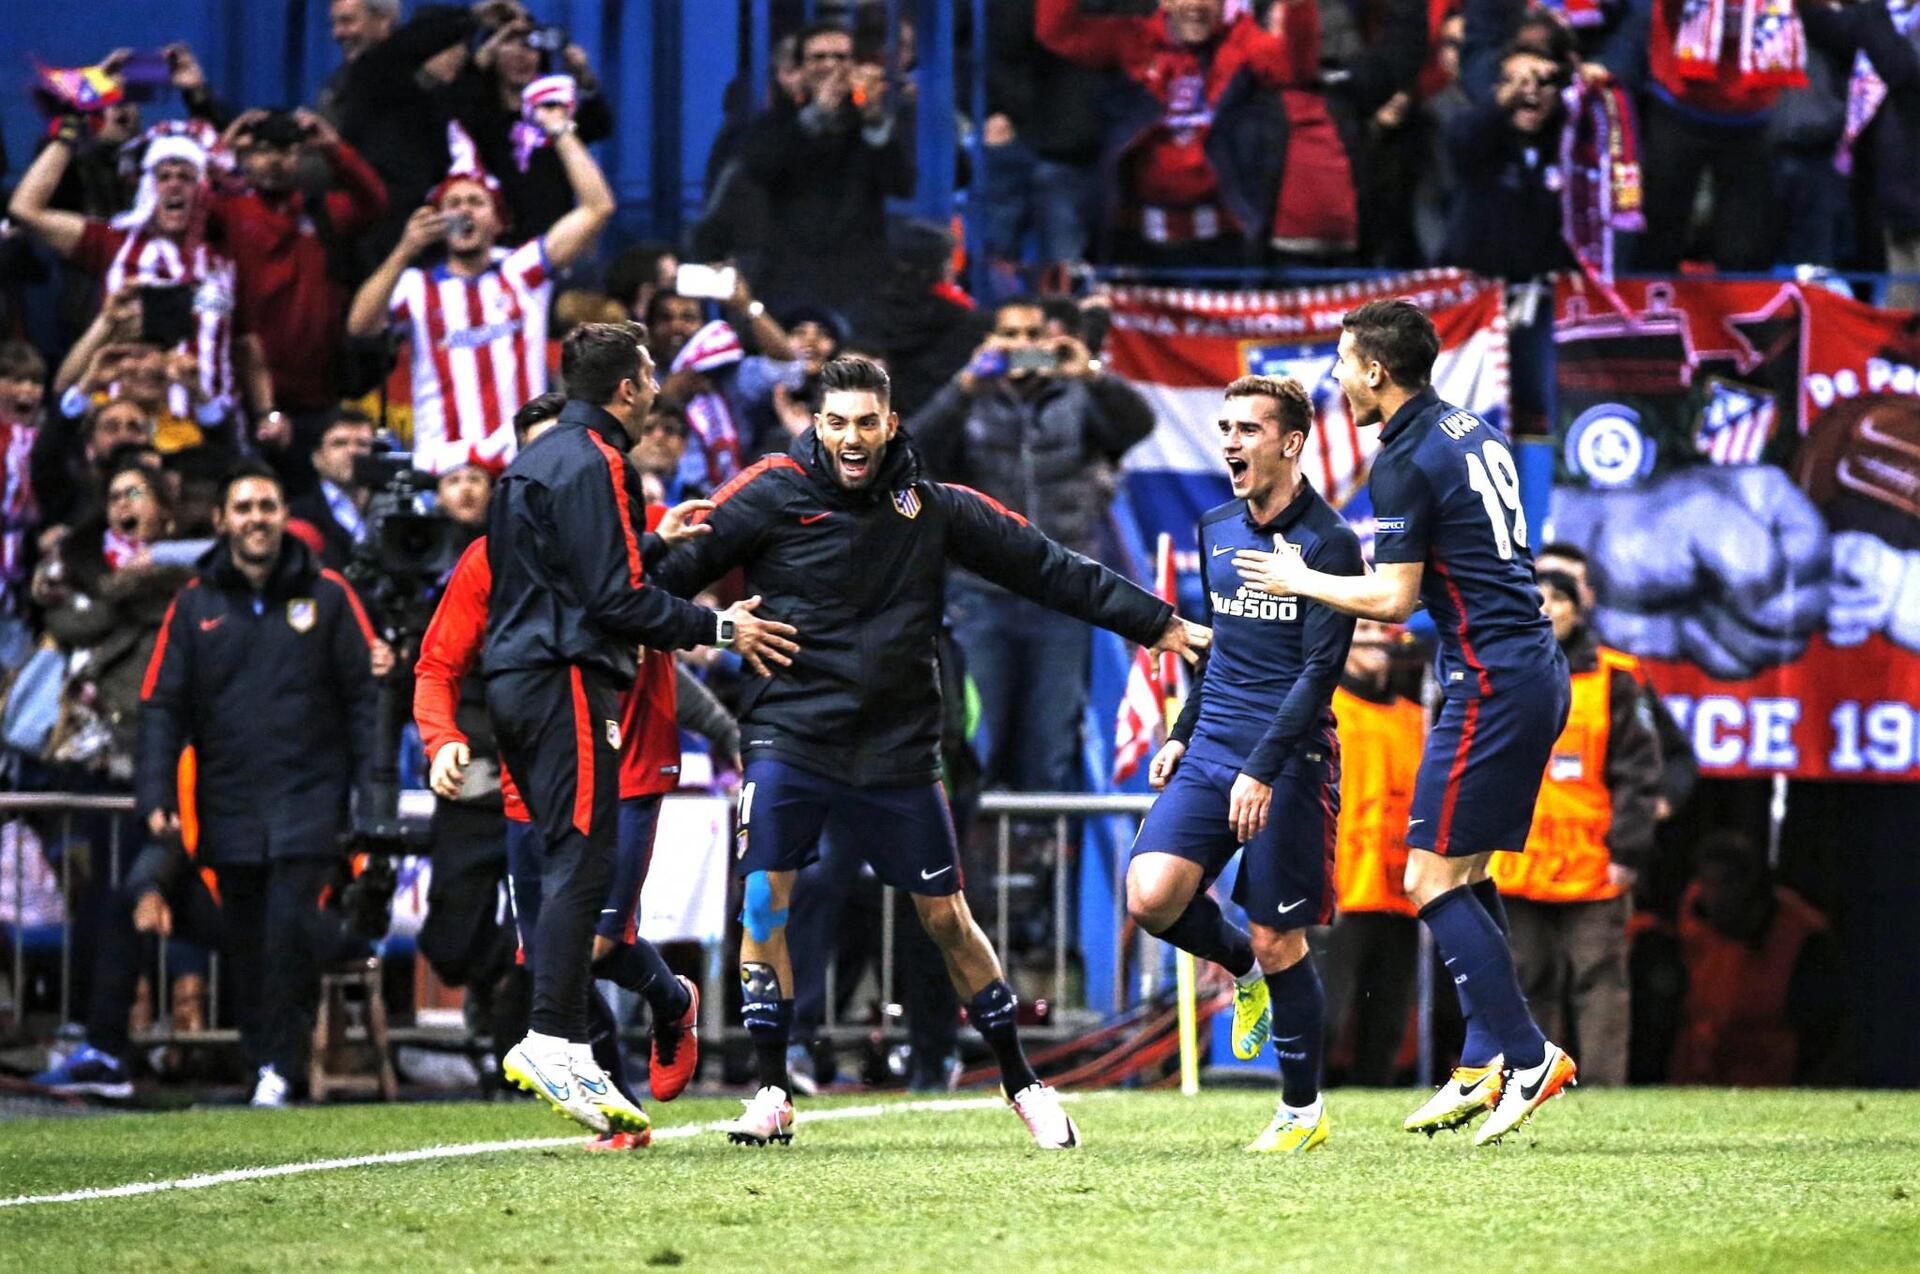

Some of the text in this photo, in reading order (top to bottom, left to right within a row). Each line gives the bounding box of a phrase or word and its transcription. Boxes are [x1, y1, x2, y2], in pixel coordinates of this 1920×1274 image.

[1865, 356, 1920, 397] Pa
[1439, 411, 1480, 441] LUCAS
[1465, 439, 1527, 560] 19
[1210, 591, 1297, 621] lus500
[1828, 700, 1920, 772] 19
